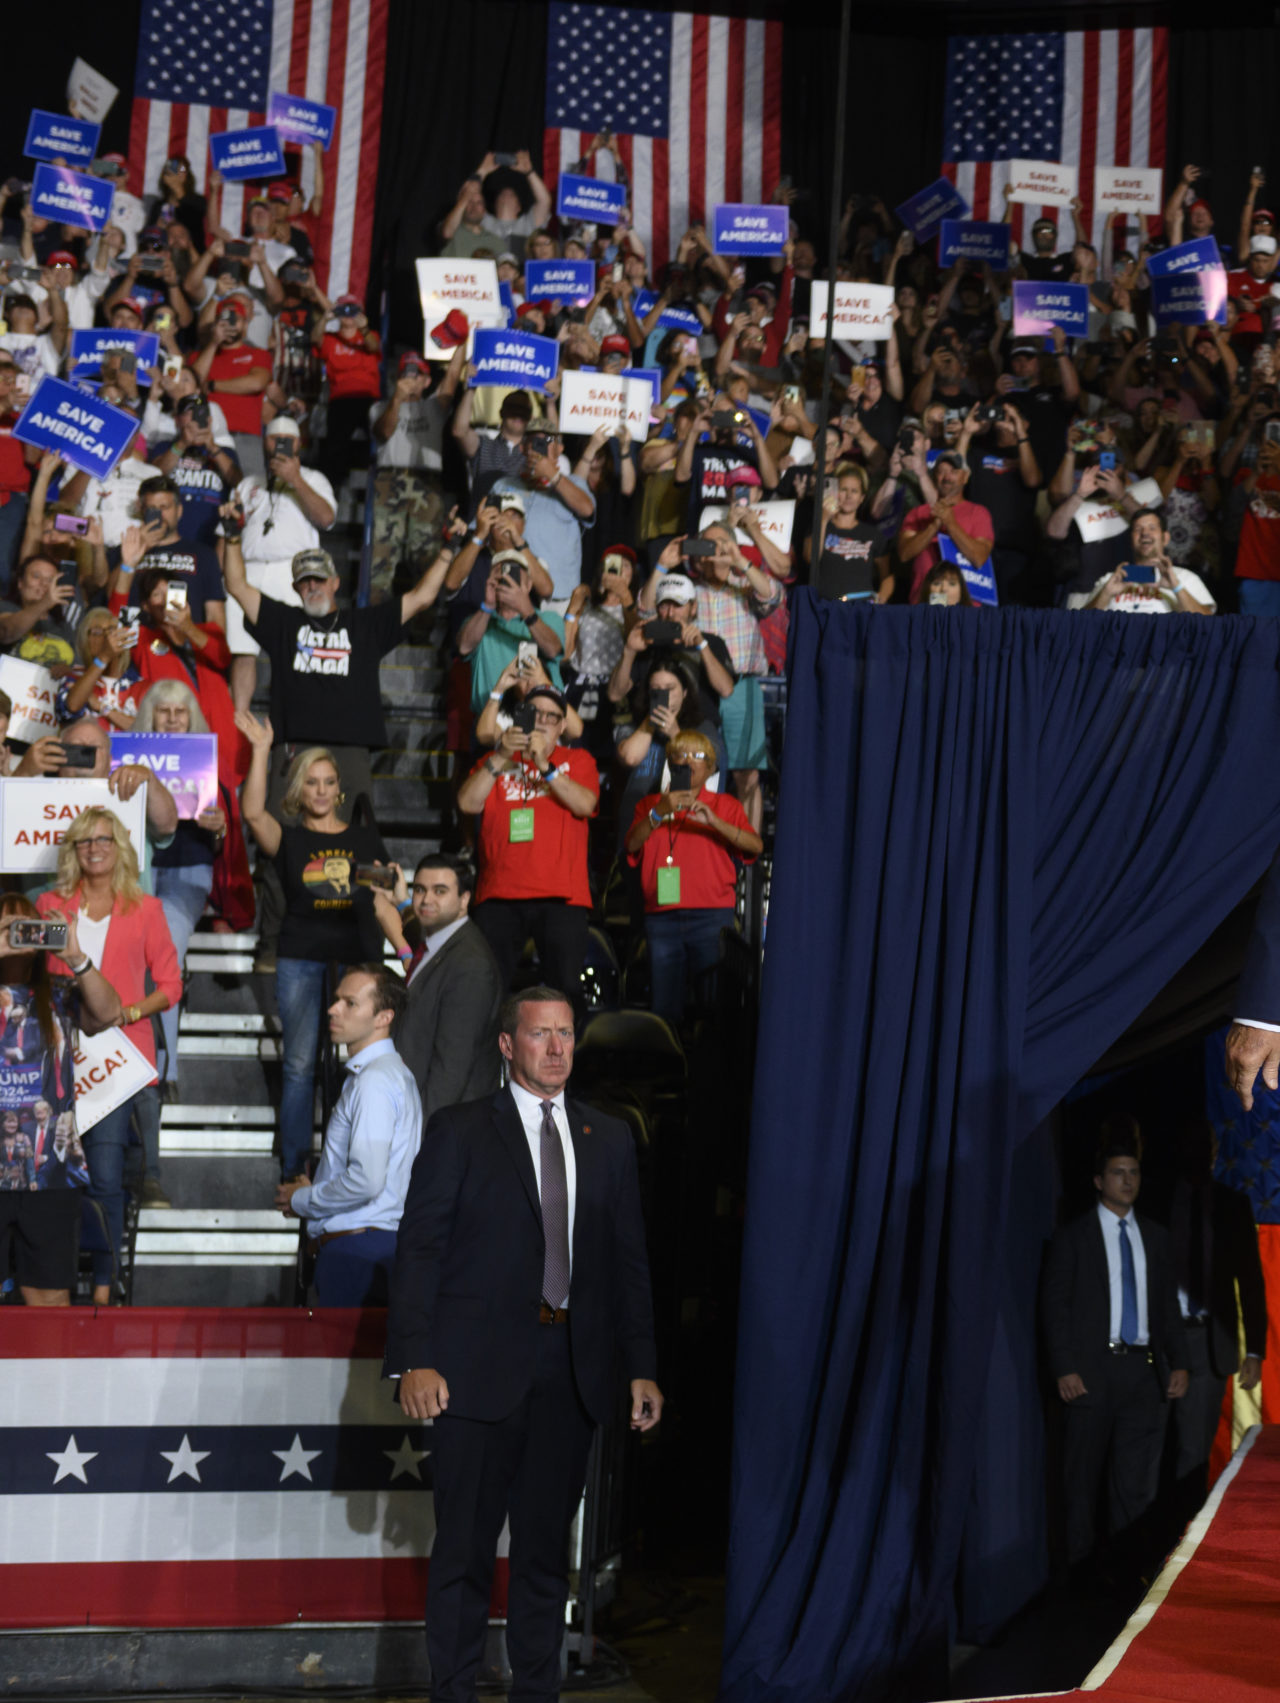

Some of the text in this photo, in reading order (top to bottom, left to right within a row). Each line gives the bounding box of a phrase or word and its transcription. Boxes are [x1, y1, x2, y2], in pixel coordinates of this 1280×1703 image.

[288, 106, 318, 123] SAVE
[49, 126, 82, 141] SAVE
[274, 116, 328, 138] AMERICA!
[33, 136, 91, 156] AMERICA!
[229, 139, 261, 154] SAVE
[219, 151, 277, 169] AMERICA!
[1029, 171, 1058, 183] SAVE
[1113, 179, 1142, 188] SAVE
[56, 181, 93, 200] SAVE
[577, 186, 608, 200] SAVE
[1016, 182, 1070, 196] AMERICA!
[1102, 191, 1154, 201] AMERICA!
[37, 192, 105, 219] AMERICA!
[563, 195, 621, 214] AMERICA!
[734, 217, 768, 228] SAVE
[719, 230, 783, 244] AMERICA!
[960, 233, 992, 245] SAVE
[946, 245, 1004, 258] AMERICA!
[1167, 252, 1200, 271] SAVE
[444, 274, 477, 285] SAVE
[543, 270, 575, 281] SAVE
[531, 283, 589, 294] AMERICA!
[835, 298, 871, 309] SAVE
[1036, 294, 1071, 306] SAVE
[1021, 309, 1084, 322] AMERICA!
[495, 342, 535, 359] SAVE
[477, 358, 550, 378] AMERICA!
[589, 390, 625, 401] SAVE
[57, 401, 104, 433] SAVE
[570, 404, 641, 422] AMERICA!
[29, 411, 113, 461] AMERICA!
[297, 624, 351, 650] ULTRA
[293, 651, 350, 676] MAGA
[122, 753, 180, 772] SAVE
[74, 1049, 128, 1102] RICA!
